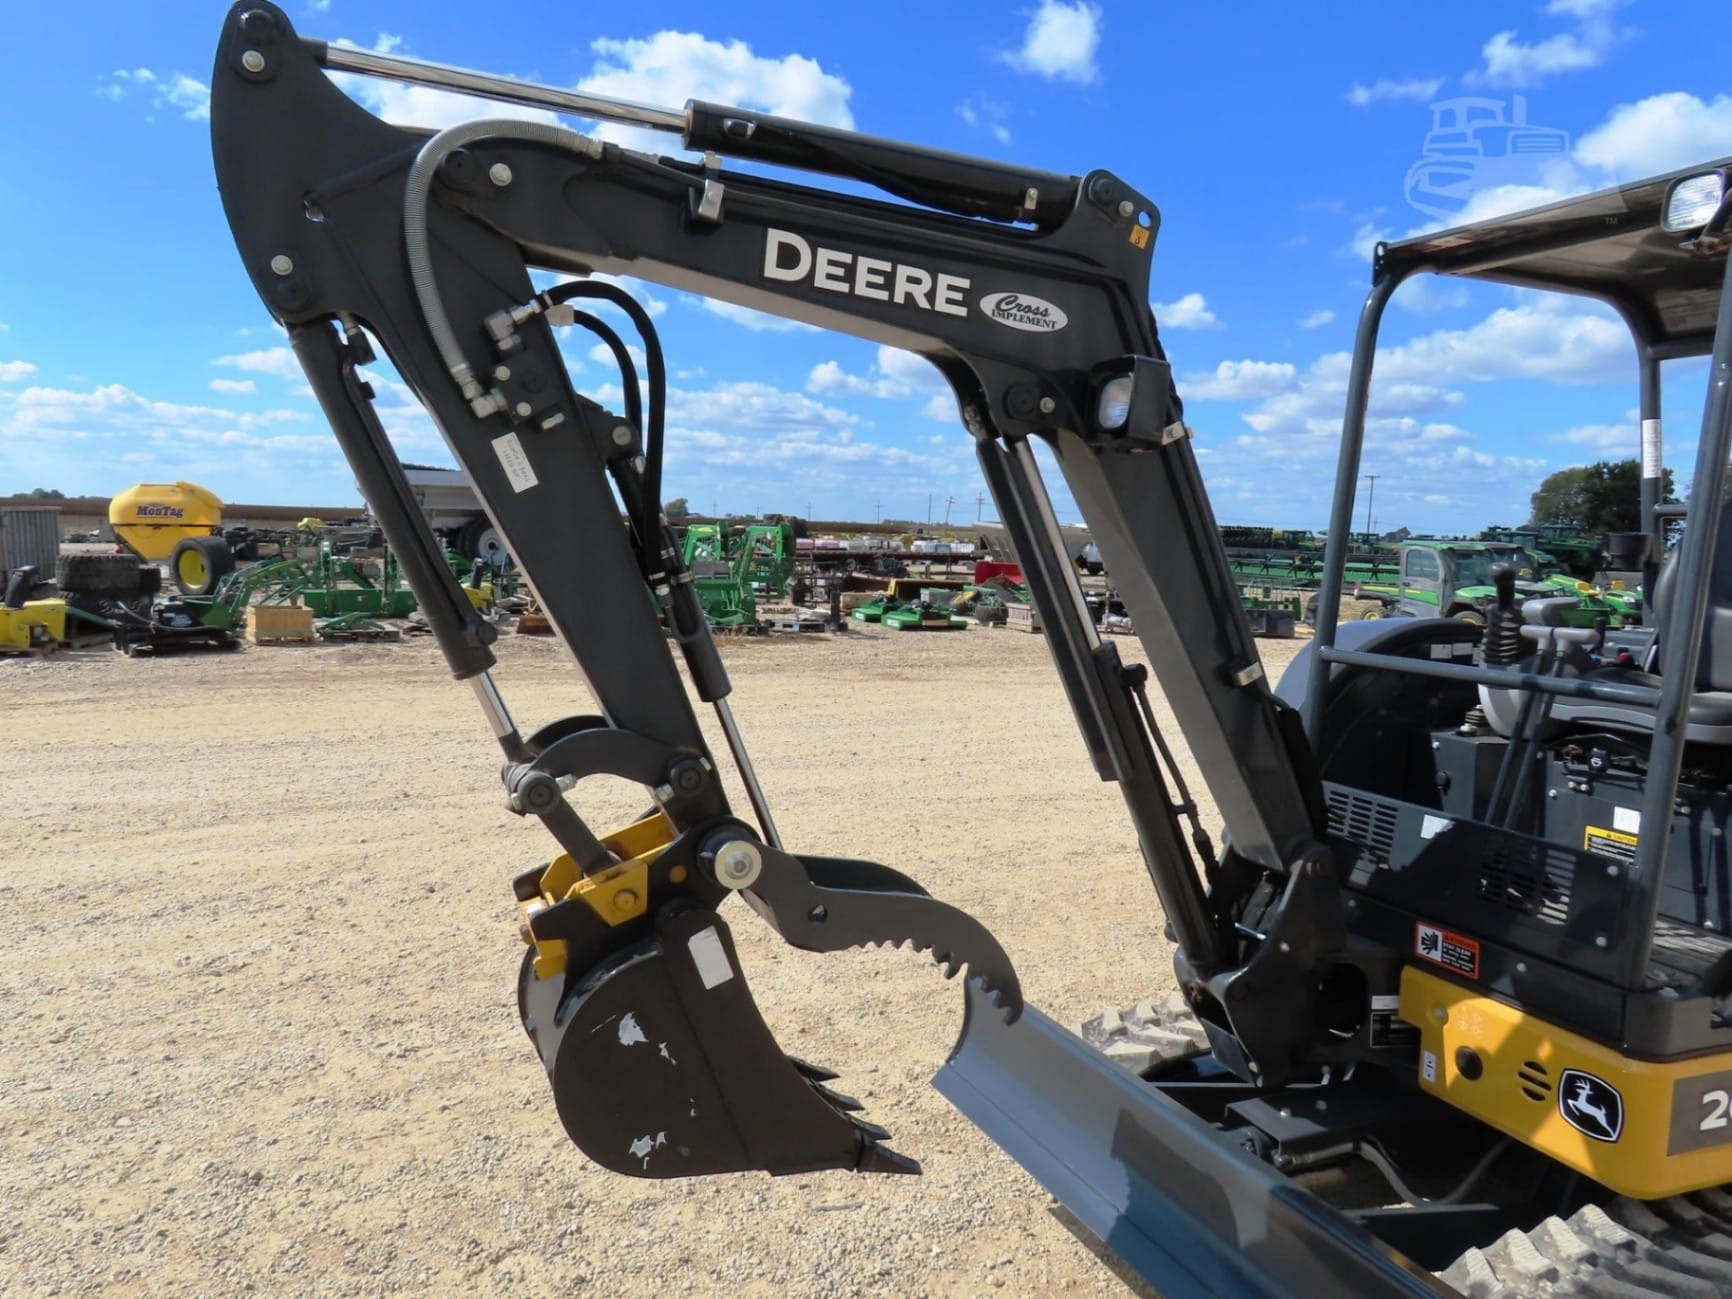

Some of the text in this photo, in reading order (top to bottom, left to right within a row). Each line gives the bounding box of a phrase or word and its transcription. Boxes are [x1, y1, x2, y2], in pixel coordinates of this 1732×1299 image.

[763, 227, 971, 317] DEERE
[991, 308, 1058, 330] IMPLEMENT
[995, 294, 1051, 317] Cross
[1700, 1089, 1732, 1131] 2
